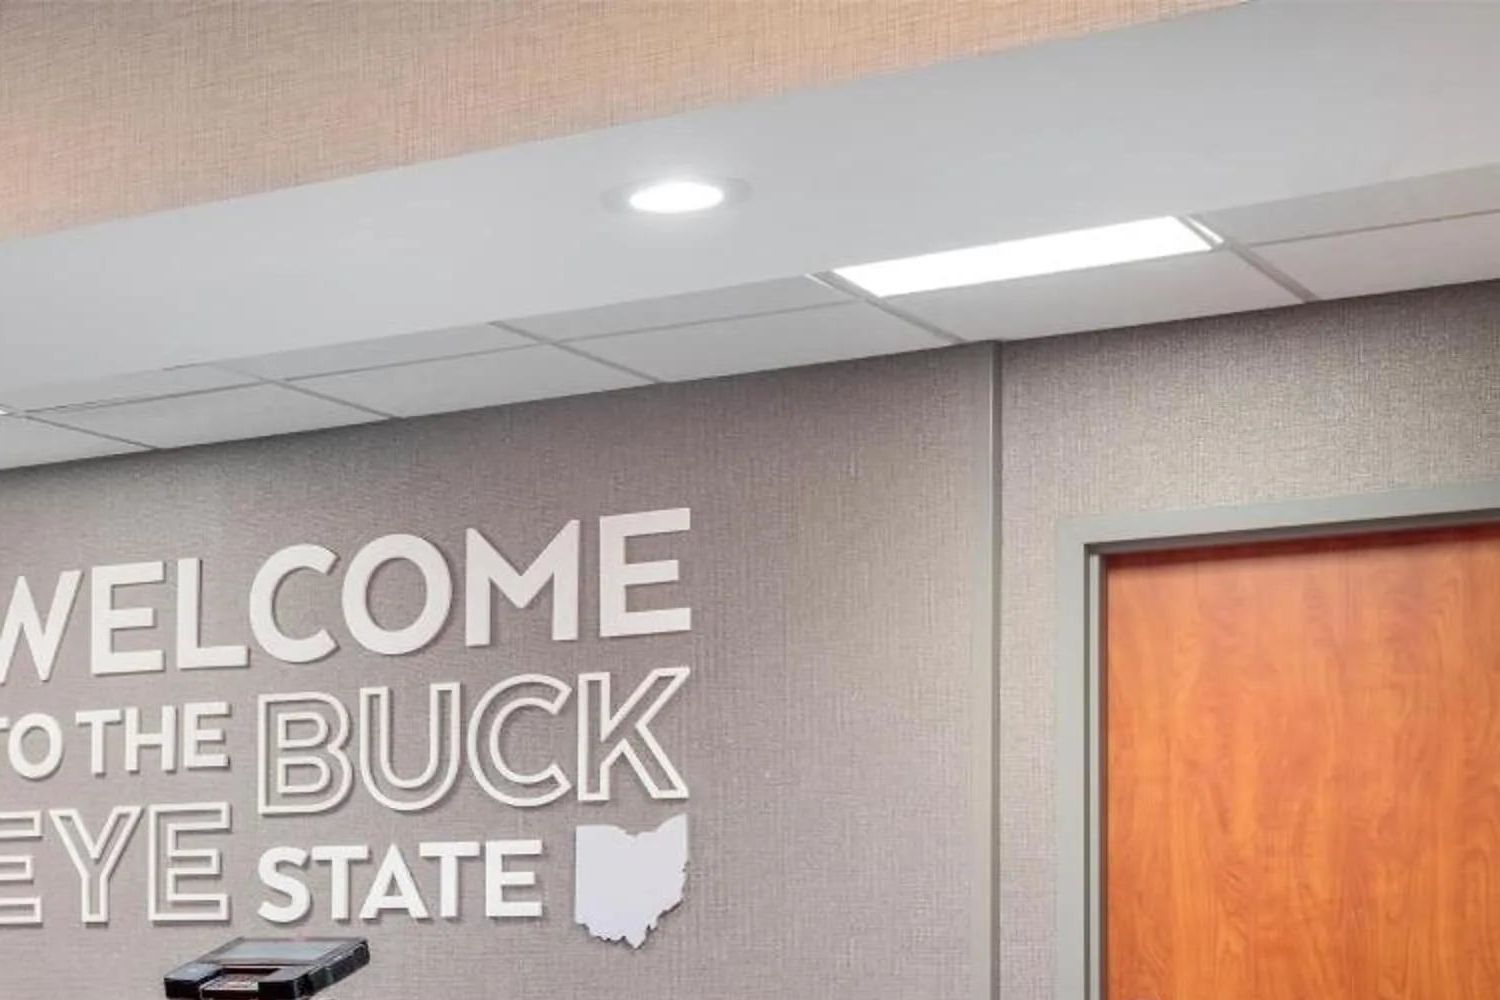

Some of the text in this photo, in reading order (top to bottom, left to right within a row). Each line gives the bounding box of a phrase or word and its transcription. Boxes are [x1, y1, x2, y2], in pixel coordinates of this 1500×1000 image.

[76, 701, 231, 775] THE
[257, 666, 691, 815] BUCK
[257, 839, 544, 924] STATE
